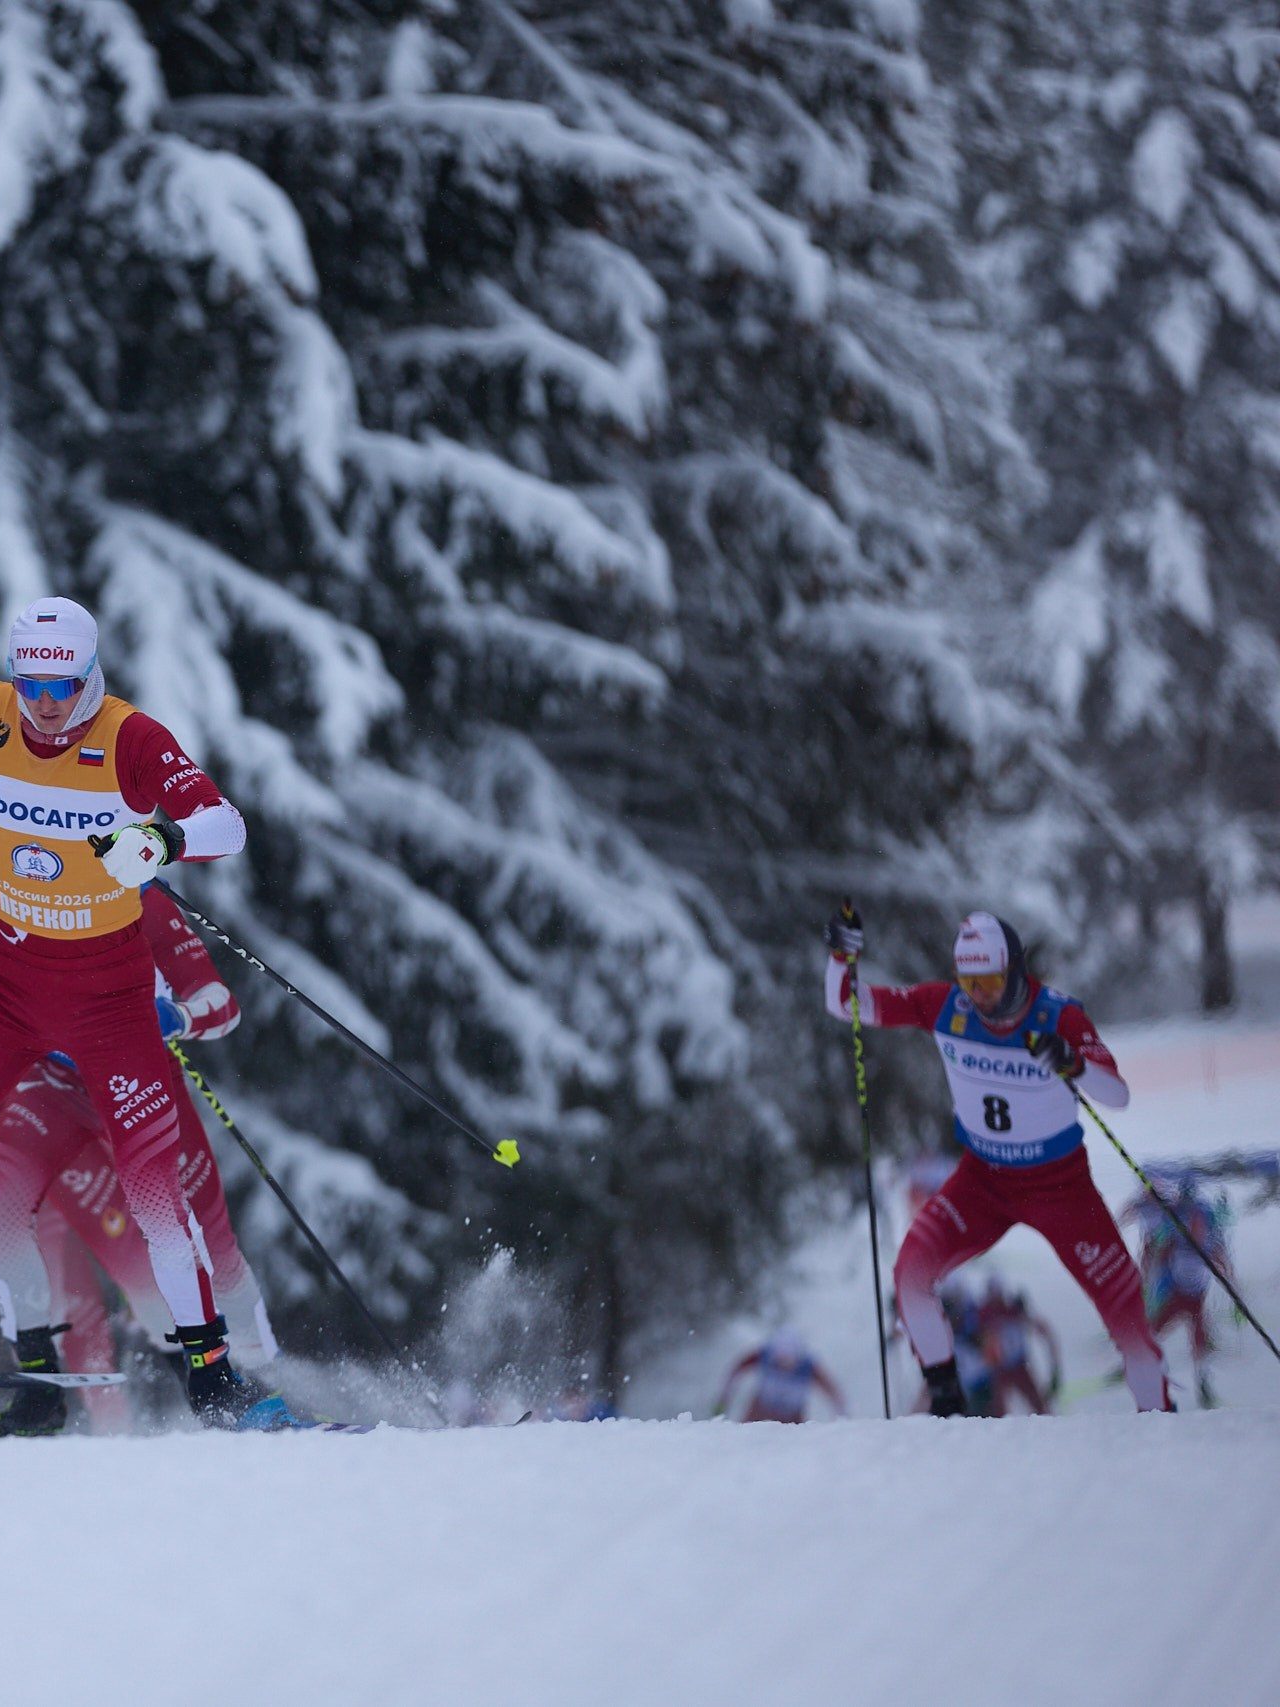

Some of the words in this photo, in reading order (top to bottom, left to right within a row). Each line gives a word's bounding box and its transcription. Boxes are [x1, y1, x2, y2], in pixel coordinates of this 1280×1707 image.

[16, 646, 74, 661] ЛУКОЙЛ
[163, 766, 205, 793] ЛУКОЙ
[3, 881, 50, 904] России
[54, 894, 92, 906] 2026
[95, 886, 126, 904] года
[114, 1081, 163, 1119] ФОСАГРО
[123, 1093, 170, 1130] BIVIUM
[982, 1093, 1012, 1132] 8
